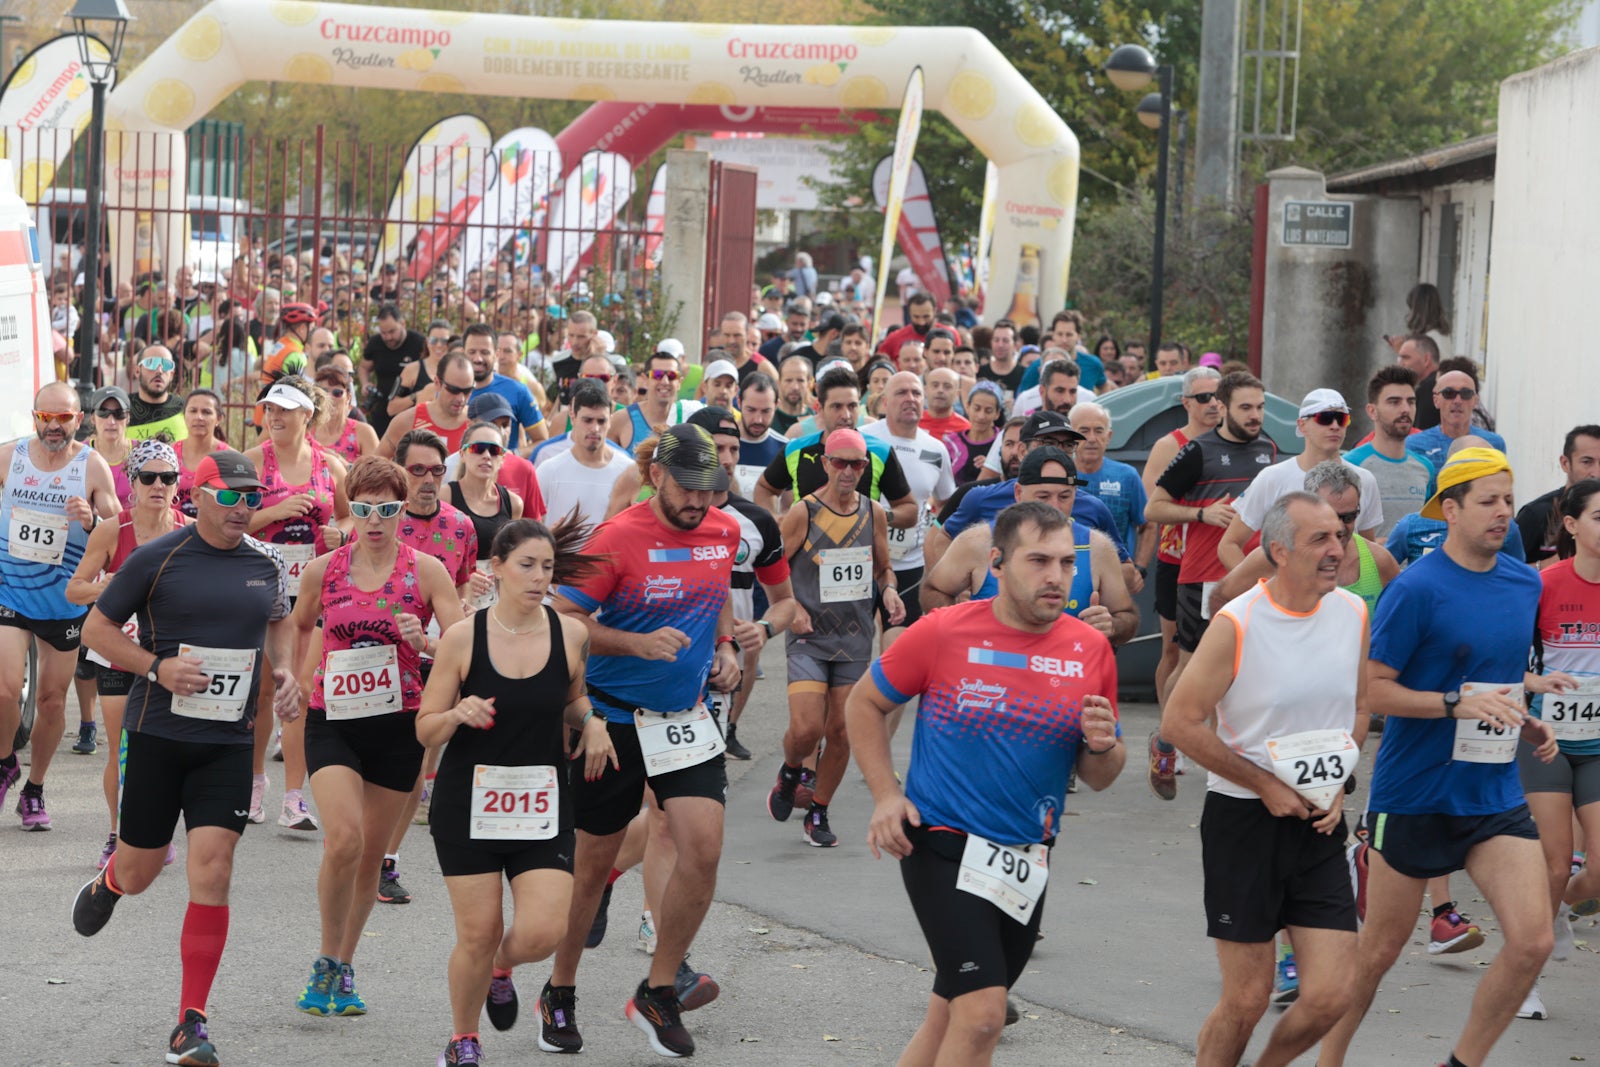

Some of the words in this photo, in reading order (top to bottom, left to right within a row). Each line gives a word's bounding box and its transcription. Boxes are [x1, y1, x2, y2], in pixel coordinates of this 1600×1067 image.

[320, 19, 452, 48] Cruzcampo
[332, 48, 395, 69] Radler
[726, 37, 859, 62] Cruzcampo
[483, 55, 582, 78] DOBLEMENTE
[586, 61, 690, 82] REFRESCANTE
[739, 65, 803, 87] Radler
[16, 61, 81, 132] Cruzcampo
[588, 101, 657, 150] EPORTE
[1306, 206, 1345, 218] CALLE
[12, 488, 74, 505] MARACEN
[19, 524, 55, 546] 813
[692, 545, 730, 562] SEUR
[832, 564, 863, 582] 619
[1029, 655, 1084, 679] SEUR
[332, 668, 392, 696] 2094
[666, 724, 696, 745] 65
[1294, 755, 1344, 785] 243
[483, 790, 549, 813] 2015
[986, 842, 1030, 883] 790
